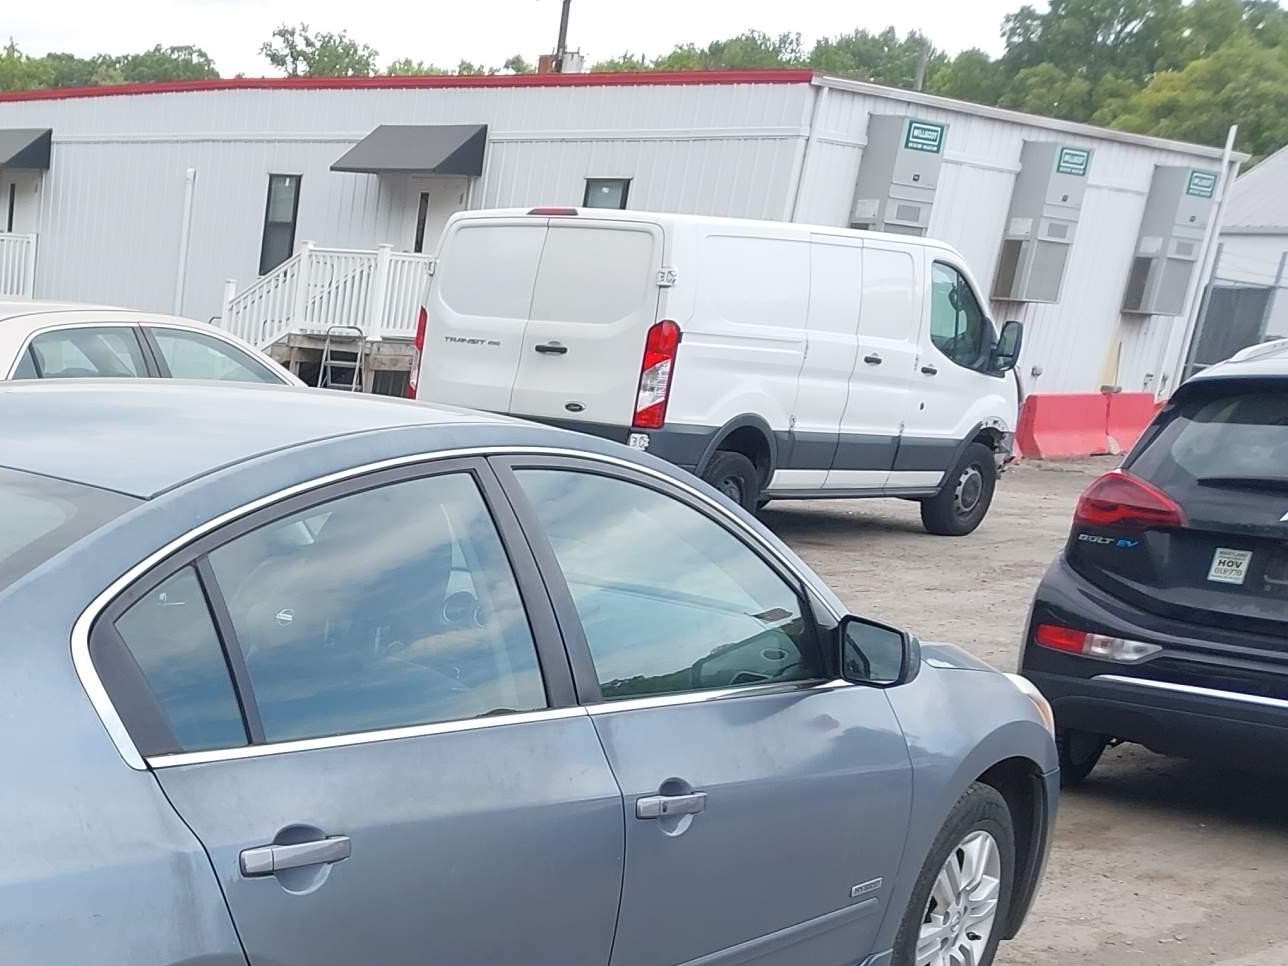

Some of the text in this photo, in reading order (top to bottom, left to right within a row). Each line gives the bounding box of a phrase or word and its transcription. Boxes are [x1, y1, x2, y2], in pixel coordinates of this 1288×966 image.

[443, 336, 486, 345] TRANSIT
[1078, 533, 1139, 547] BOLT EV
[1217, 559, 1243, 569] HOV
